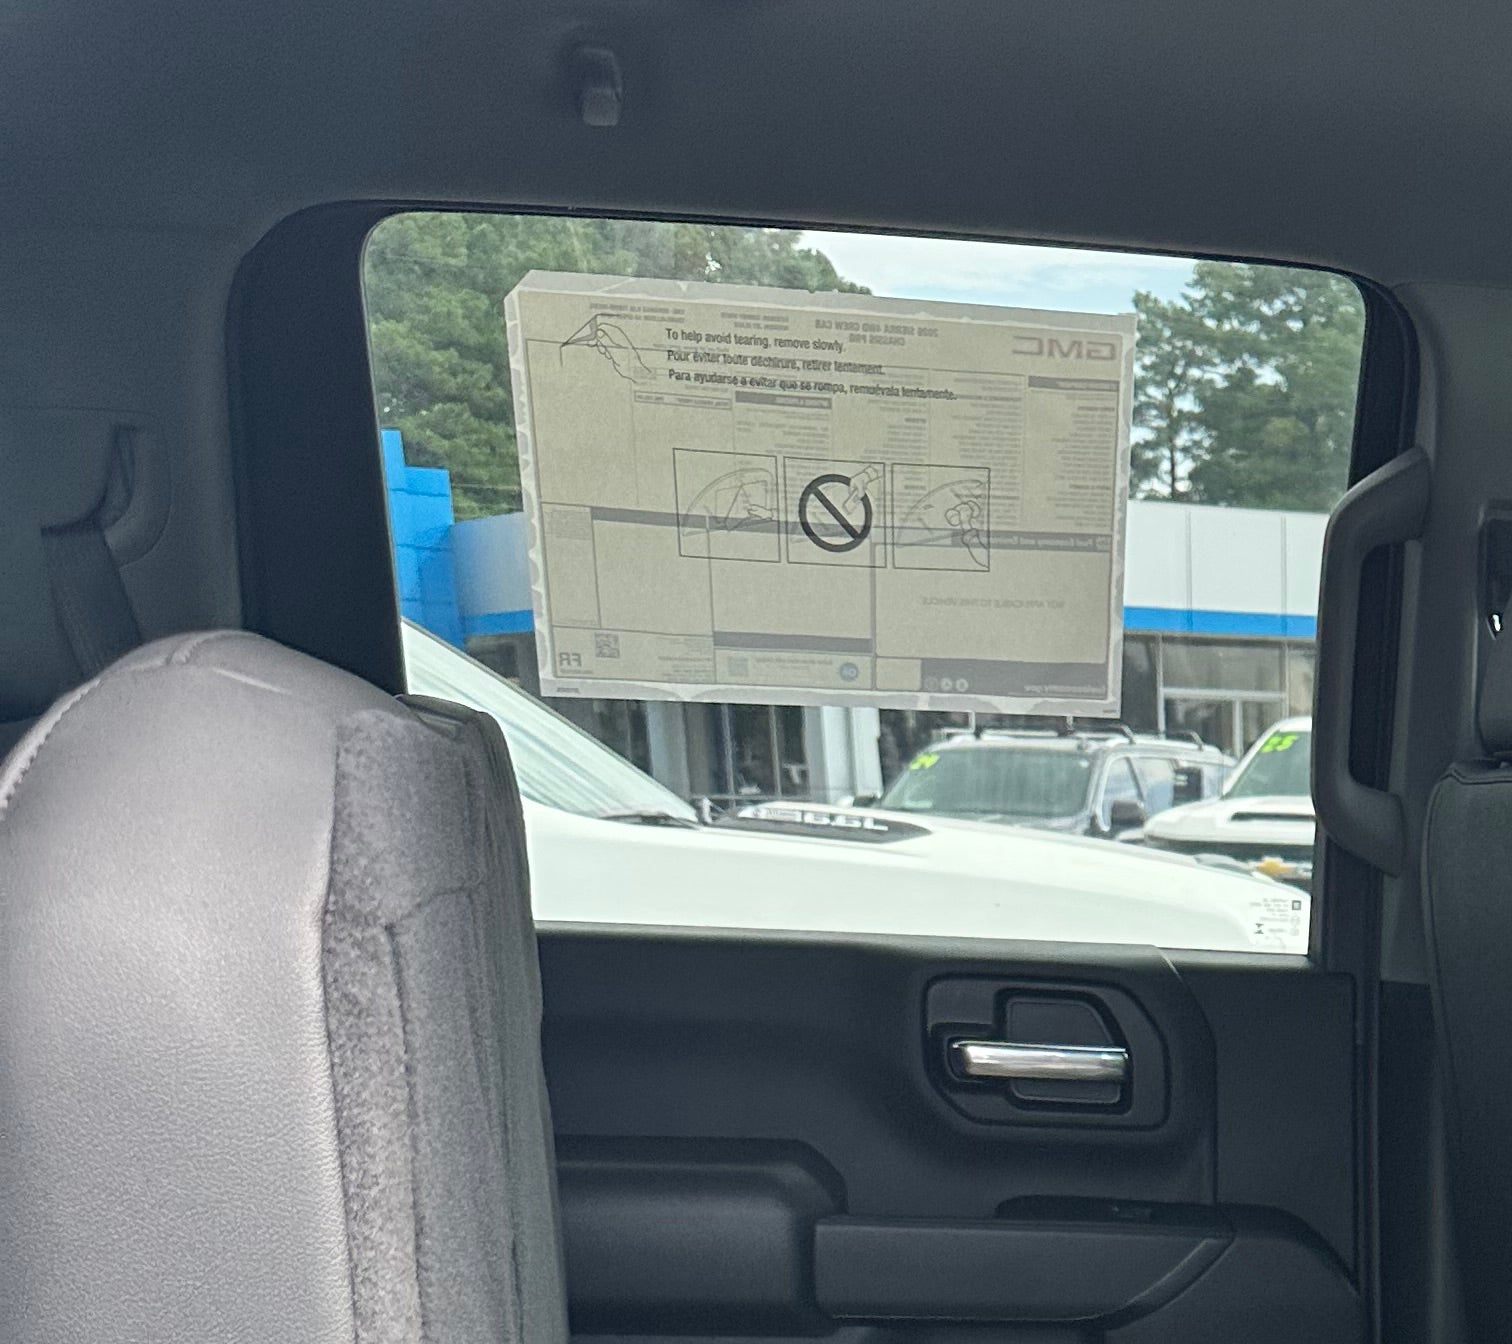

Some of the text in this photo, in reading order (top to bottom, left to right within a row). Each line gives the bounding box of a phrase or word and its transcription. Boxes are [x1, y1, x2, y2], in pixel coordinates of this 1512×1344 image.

[665, 328, 678, 340] To
[681, 329, 702, 343] help
[705, 332, 732, 344] avoid
[774, 338, 810, 349] remove
[667, 350, 693, 362] Pour
[668, 368, 691, 381] Para
